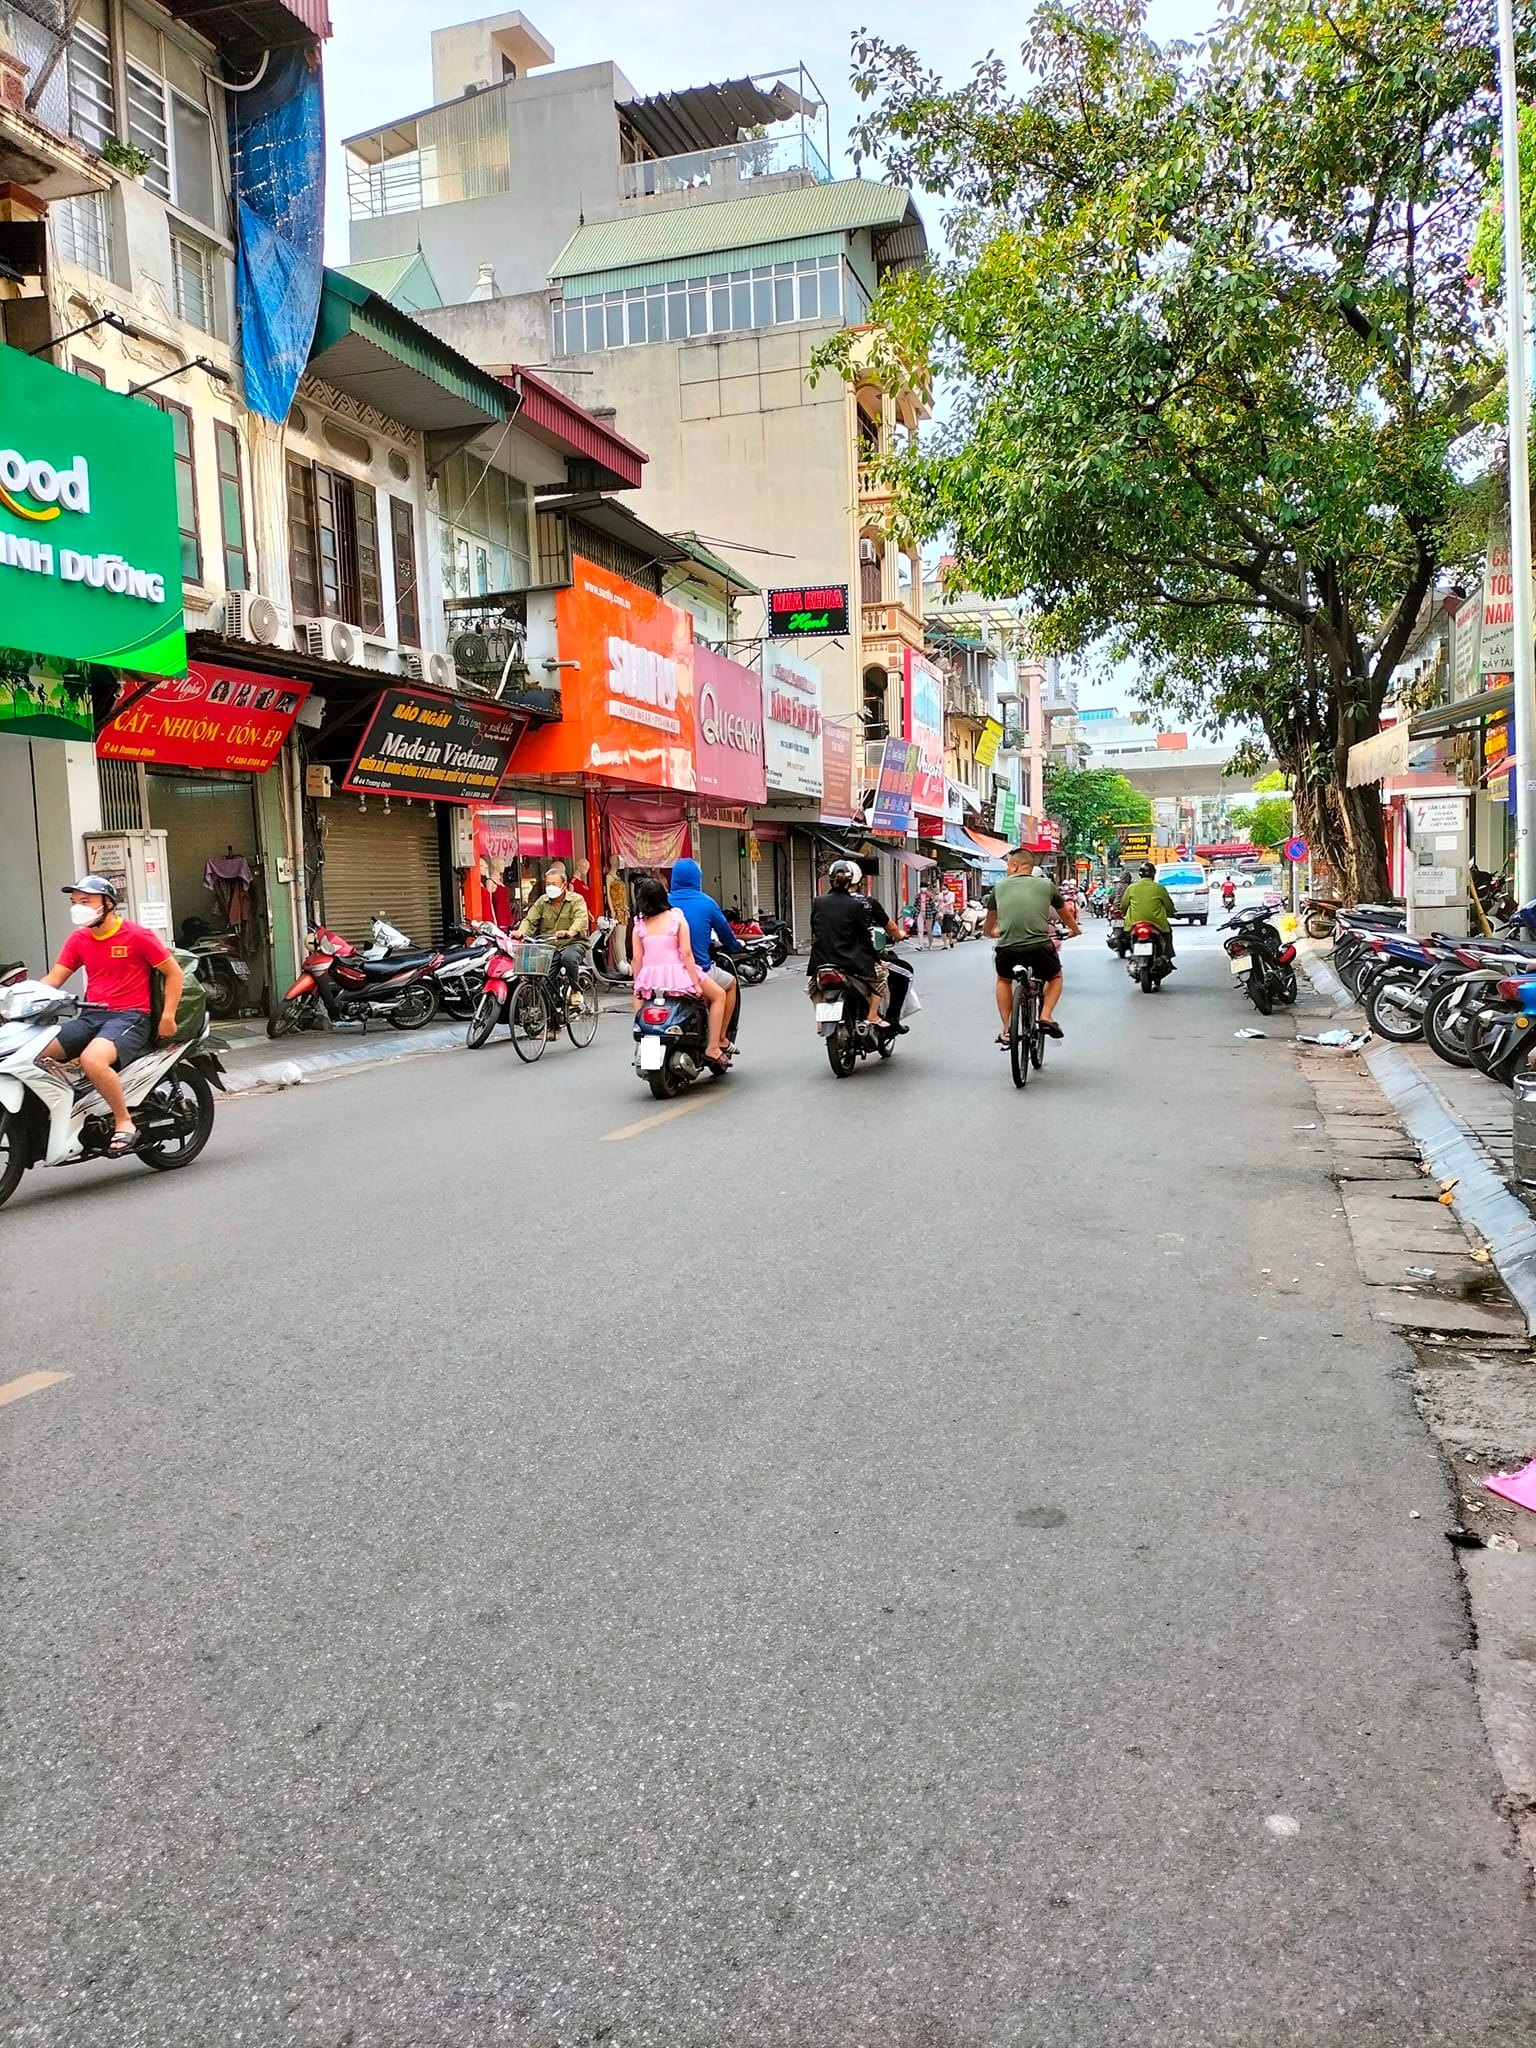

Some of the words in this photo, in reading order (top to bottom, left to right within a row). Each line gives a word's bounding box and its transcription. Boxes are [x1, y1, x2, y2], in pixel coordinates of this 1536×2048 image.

[60, 549, 165, 603] DƯỠNG
[113, 704, 152, 734] CẮT
[157, 716, 220, 744] NHUỘM
[227, 719, 260, 746] UỐN
[261, 725, 283, 748] ÉP
[393, 701, 416, 721] BẢO
[416, 709, 453, 729] NGÂN
[378, 732, 426, 761] Made
[424, 740, 443, 764] in
[442, 742, 499, 772] Vietnam
